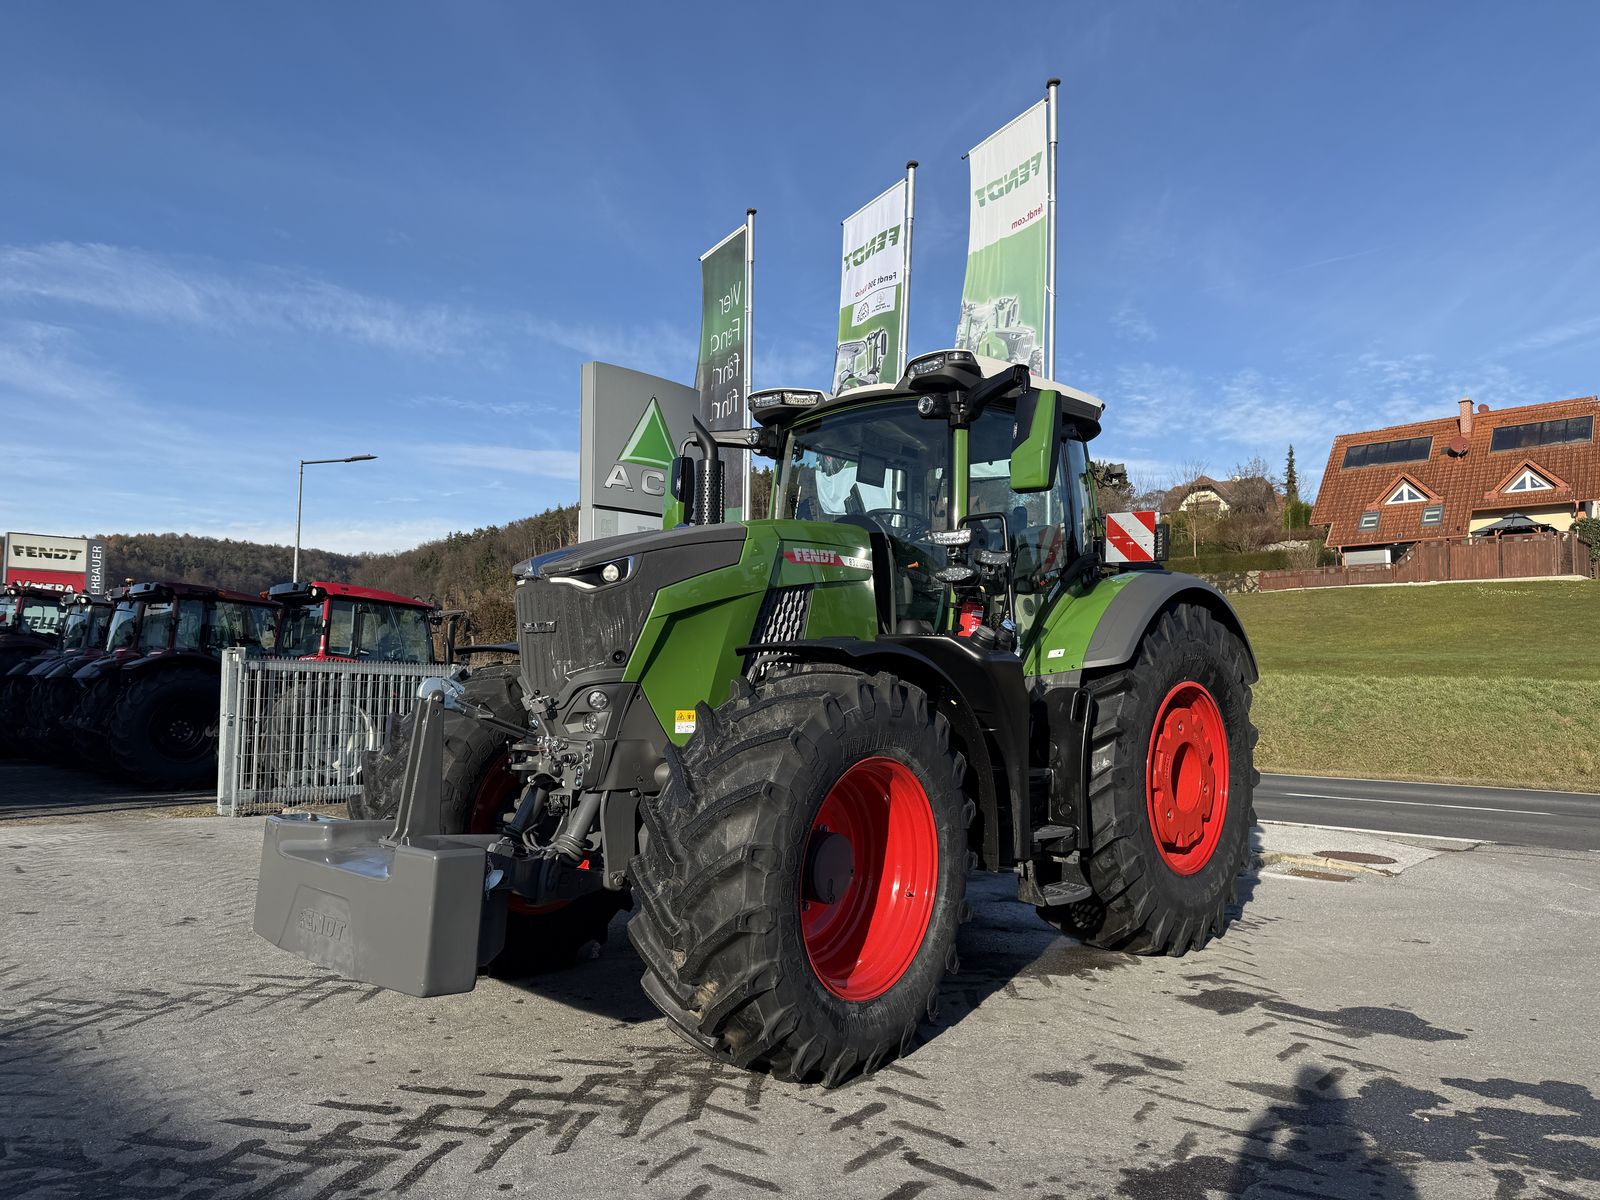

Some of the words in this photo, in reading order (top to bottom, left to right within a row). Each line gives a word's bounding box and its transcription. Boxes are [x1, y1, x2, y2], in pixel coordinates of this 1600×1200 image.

[12, 545, 83, 561] FENDT
[793, 548, 836, 563] FENDT
[91, 545, 102, 595] ERBAUER
